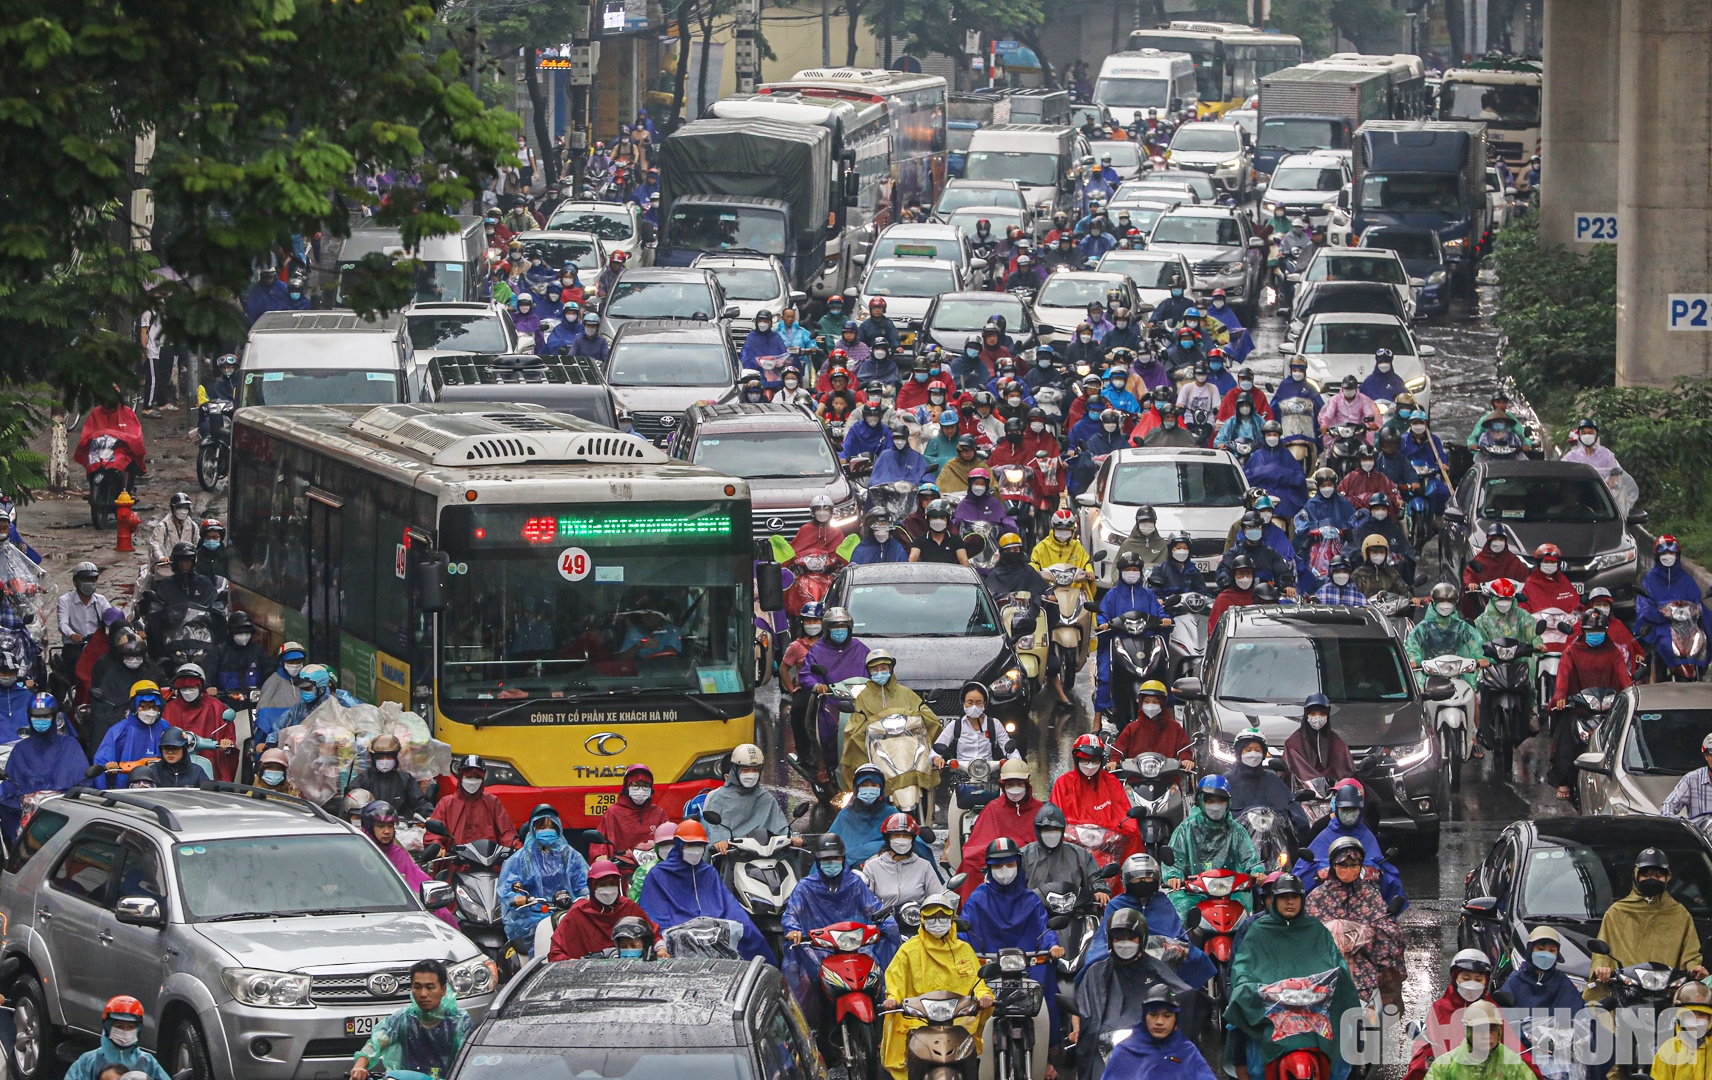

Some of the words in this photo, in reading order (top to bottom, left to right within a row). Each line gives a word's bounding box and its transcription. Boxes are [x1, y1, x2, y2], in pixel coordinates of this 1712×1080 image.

[1577, 217, 1618, 239] P23
[1671, 299, 1712, 326] P2
[396, 546, 406, 576] 49
[562, 554, 585, 575] 49
[530, 711, 554, 723] CÔNG
[556, 712, 566, 723] TY
[568, 708, 580, 722] CỔ
[581, 709, 605, 722] PHẦN
[606, 712, 617, 722] XE
[619, 710, 648, 722] KHÁCH
[649, 710, 661, 721] HÀ
[662, 709, 678, 722] NỘI
[573, 765, 630, 778] THAC
[597, 795, 616, 805] 29B
